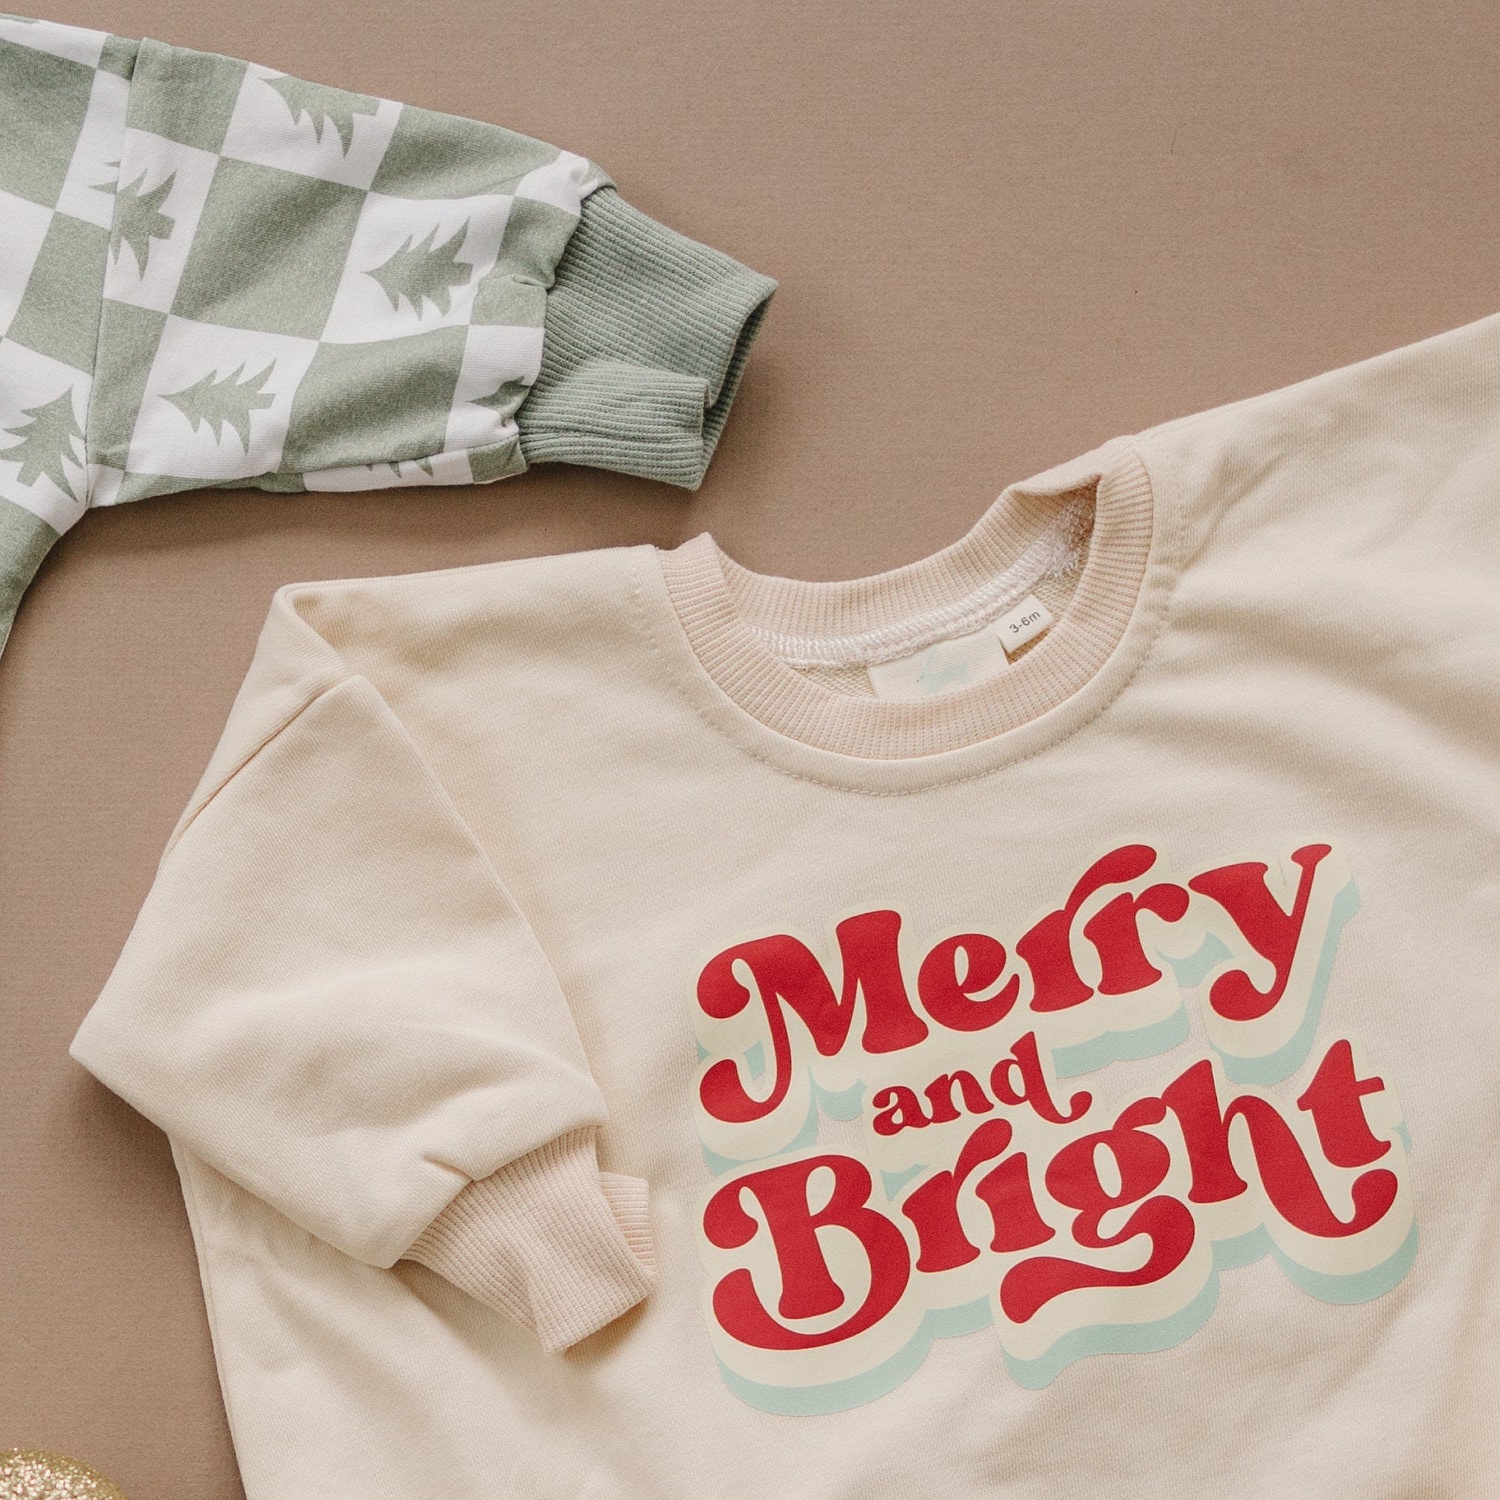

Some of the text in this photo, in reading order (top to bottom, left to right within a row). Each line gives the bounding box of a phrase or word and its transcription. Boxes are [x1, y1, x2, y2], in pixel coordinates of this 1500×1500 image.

[1009, 611, 1041, 633] 3-6m
[697, 843, 1332, 1124] Merry
[873, 1031, 1093, 1137] and
[703, 1039, 1398, 1351] Bright
